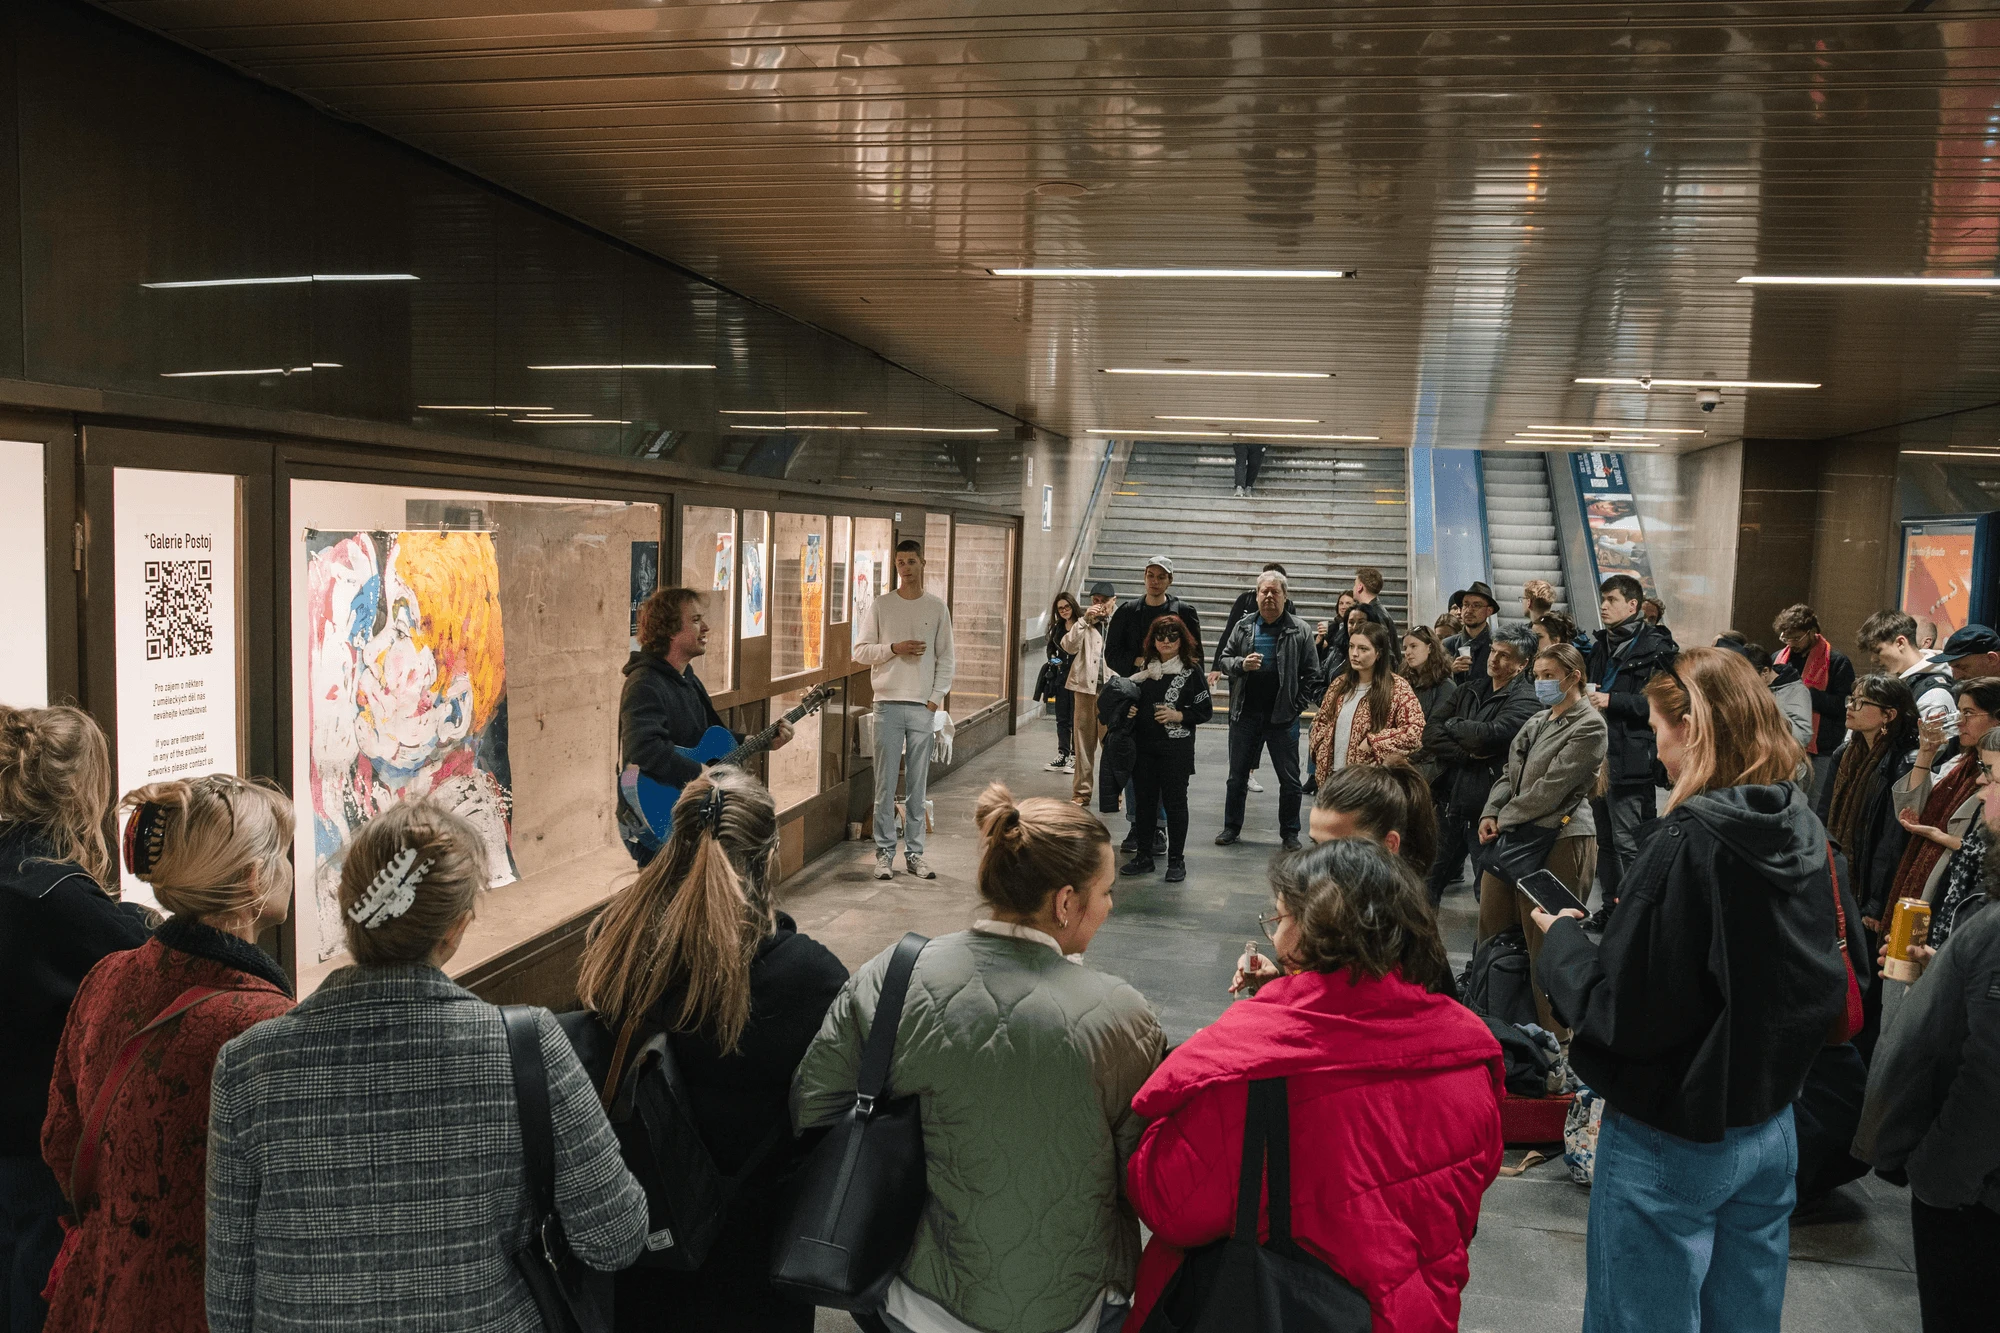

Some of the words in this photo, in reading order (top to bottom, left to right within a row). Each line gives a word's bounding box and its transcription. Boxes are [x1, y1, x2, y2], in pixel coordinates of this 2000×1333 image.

[185, 533, 212, 552] Postoj
[155, 684, 163, 692] Pro
[188, 693, 196, 702] děl
[179, 705, 207, 716] kontaktovat
[155, 739, 159, 747] If
[160, 740, 169, 749] you
[180, 731, 204, 743] interested
[153, 753, 158, 761] in
[160, 753, 168, 762] any
[170, 750, 175, 758] of
[176, 749, 184, 757] the
[185, 744, 207, 756] exhibited
[148, 765, 170, 776] artworks
[172, 762, 188, 774] please
[189, 759, 207, 768] contact
